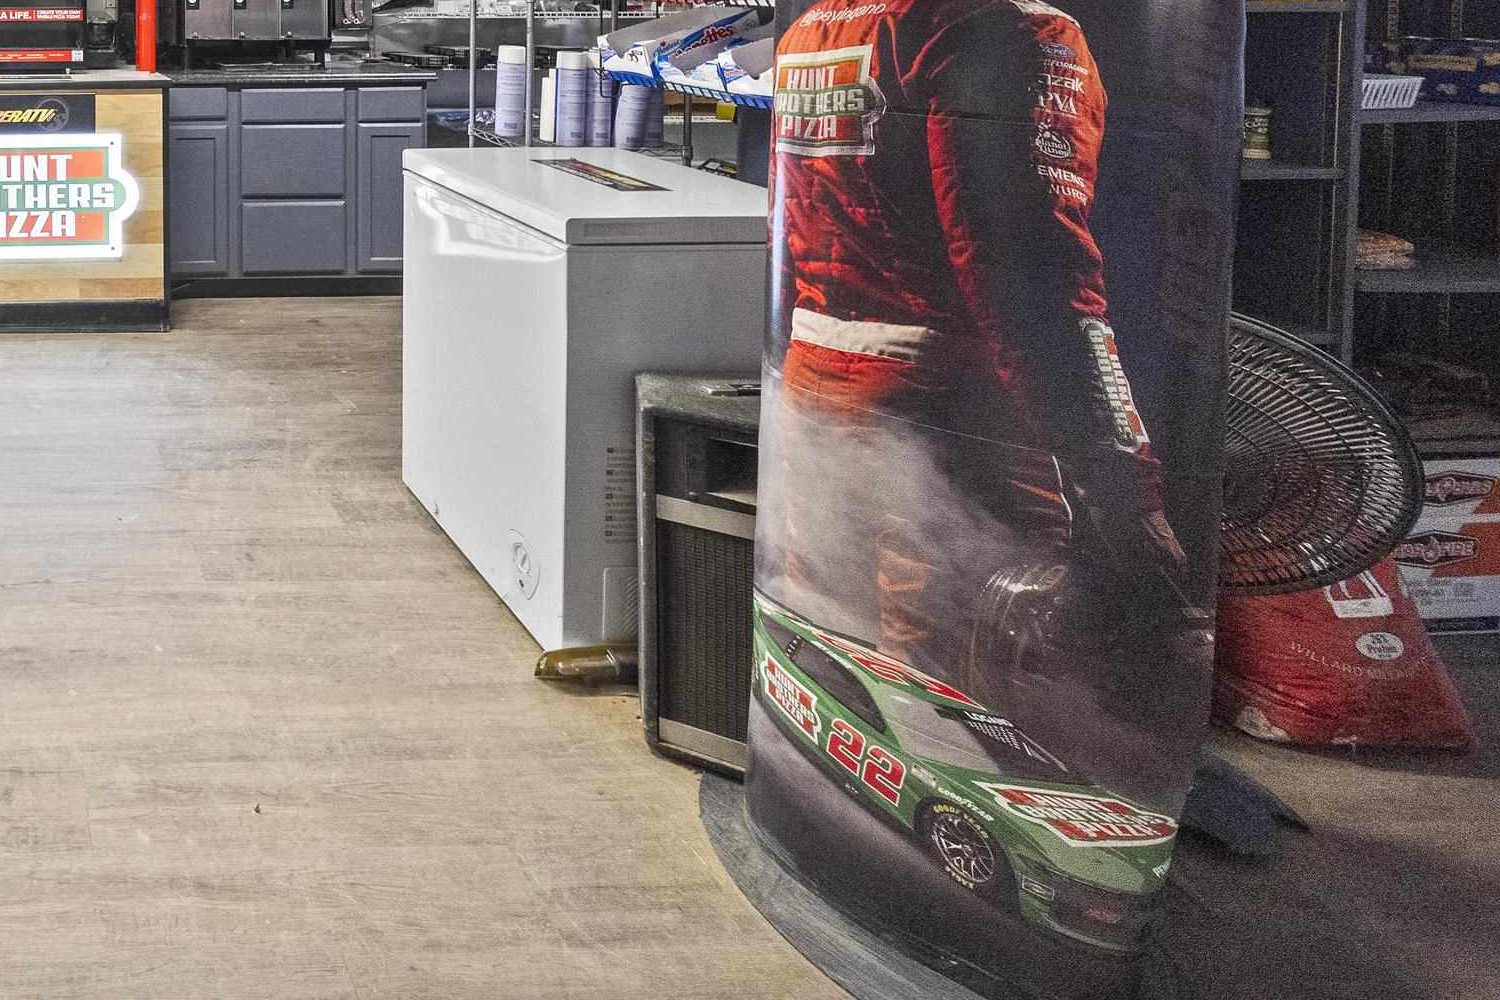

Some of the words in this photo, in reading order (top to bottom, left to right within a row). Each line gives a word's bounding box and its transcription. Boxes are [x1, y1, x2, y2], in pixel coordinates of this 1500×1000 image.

[9, 11, 32, 19] LIFE.
[786, 65, 839, 90] HUNT
[776, 88, 866, 115] ROTHERS
[825, 717, 907, 808] 22
